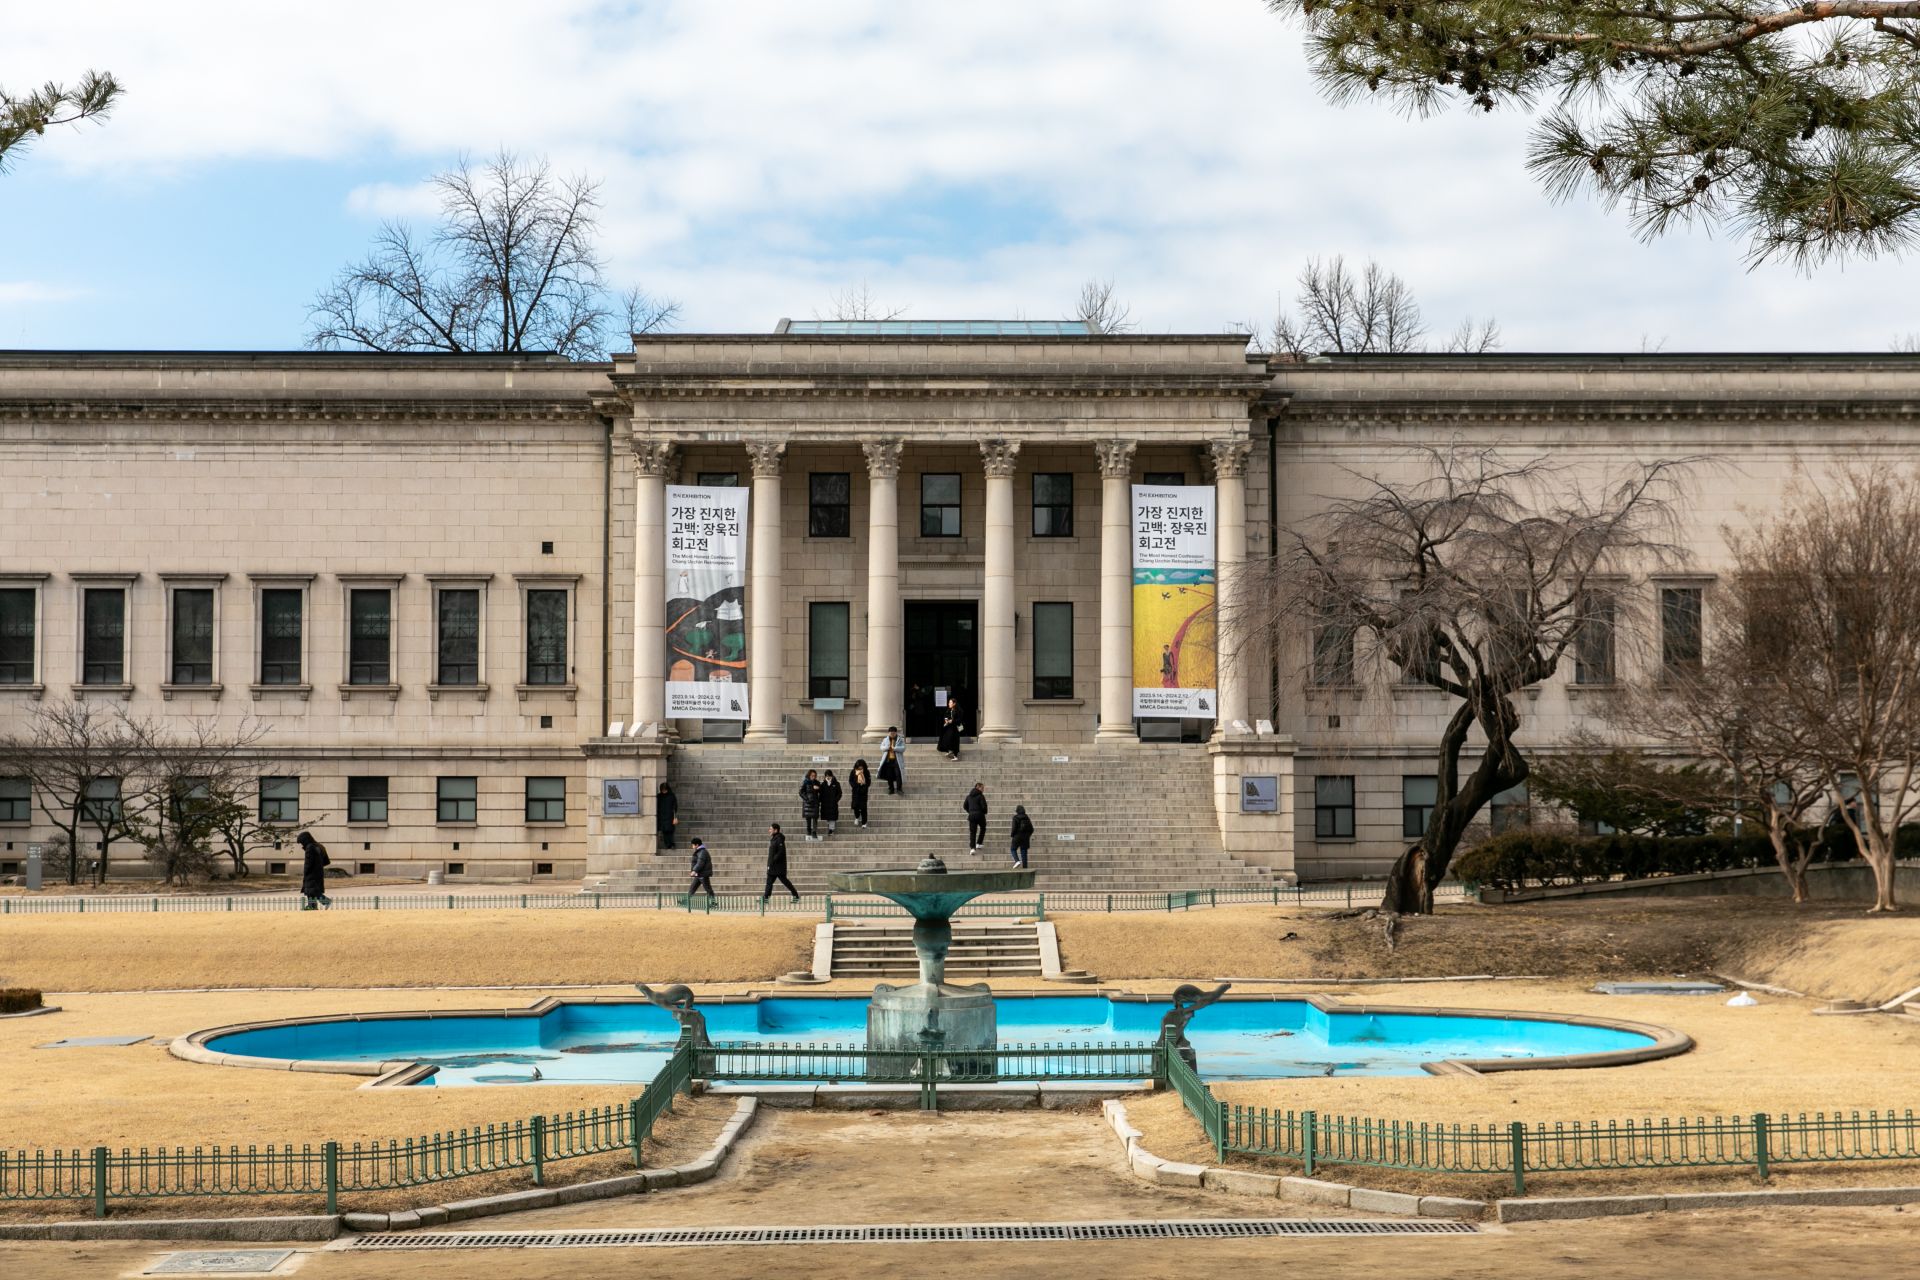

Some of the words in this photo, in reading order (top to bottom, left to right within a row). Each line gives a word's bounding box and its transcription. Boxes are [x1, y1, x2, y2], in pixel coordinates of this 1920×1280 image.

[672, 507, 696, 519] 가장
[700, 507, 736, 520] 진지한
[1138, 506, 1162, 519] 가장
[1167, 507, 1203, 520] 진지한
[672, 522, 700, 535] 고백:
[704, 523, 739, 536] 장욱진
[1138, 522, 1166, 534] 고백:
[1171, 522, 1207, 535] 장욱진
[672, 537, 708, 551] 회고전
[1139, 536, 1176, 550] 회고전
